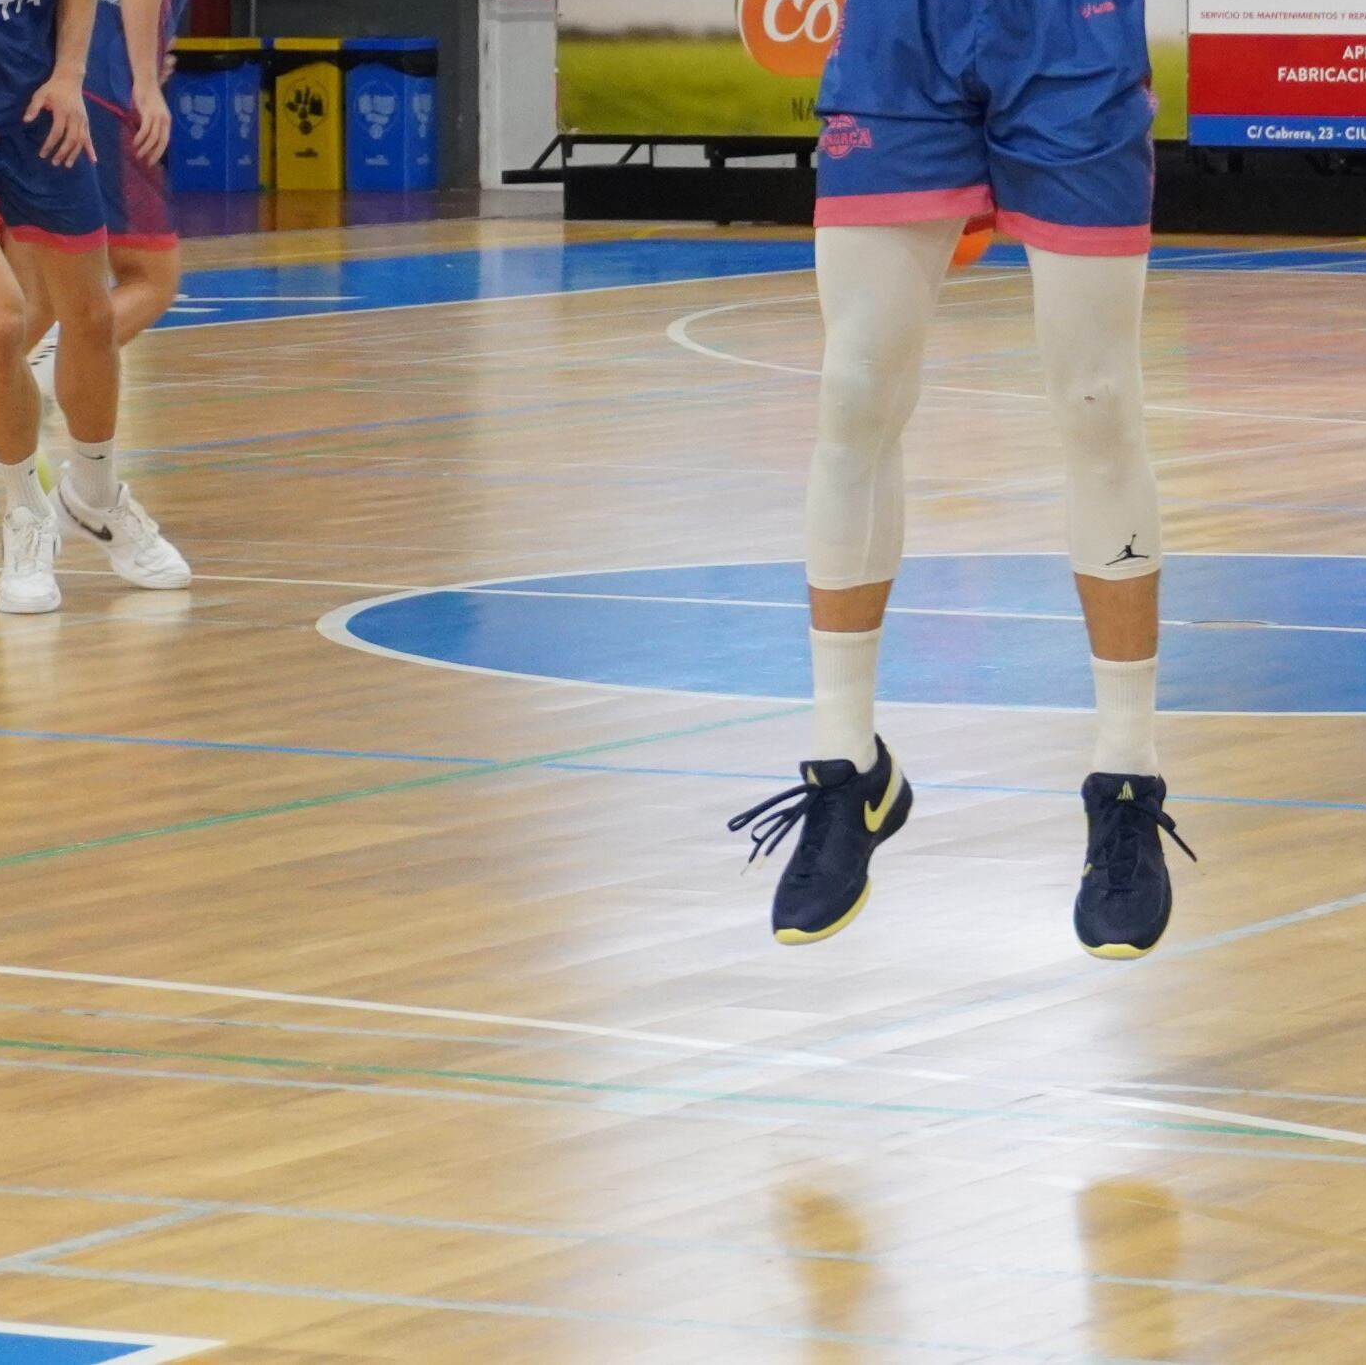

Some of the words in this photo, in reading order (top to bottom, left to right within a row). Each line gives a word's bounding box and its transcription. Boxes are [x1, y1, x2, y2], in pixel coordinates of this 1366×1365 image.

[1200, 11, 1240, 20] SERVICIO
[1243, 11, 1254, 20] DE
[1247, 126, 1262, 140] C/
[1265, 126, 1316, 142] Cabrera,
[1318, 127, 1333, 140] 23
